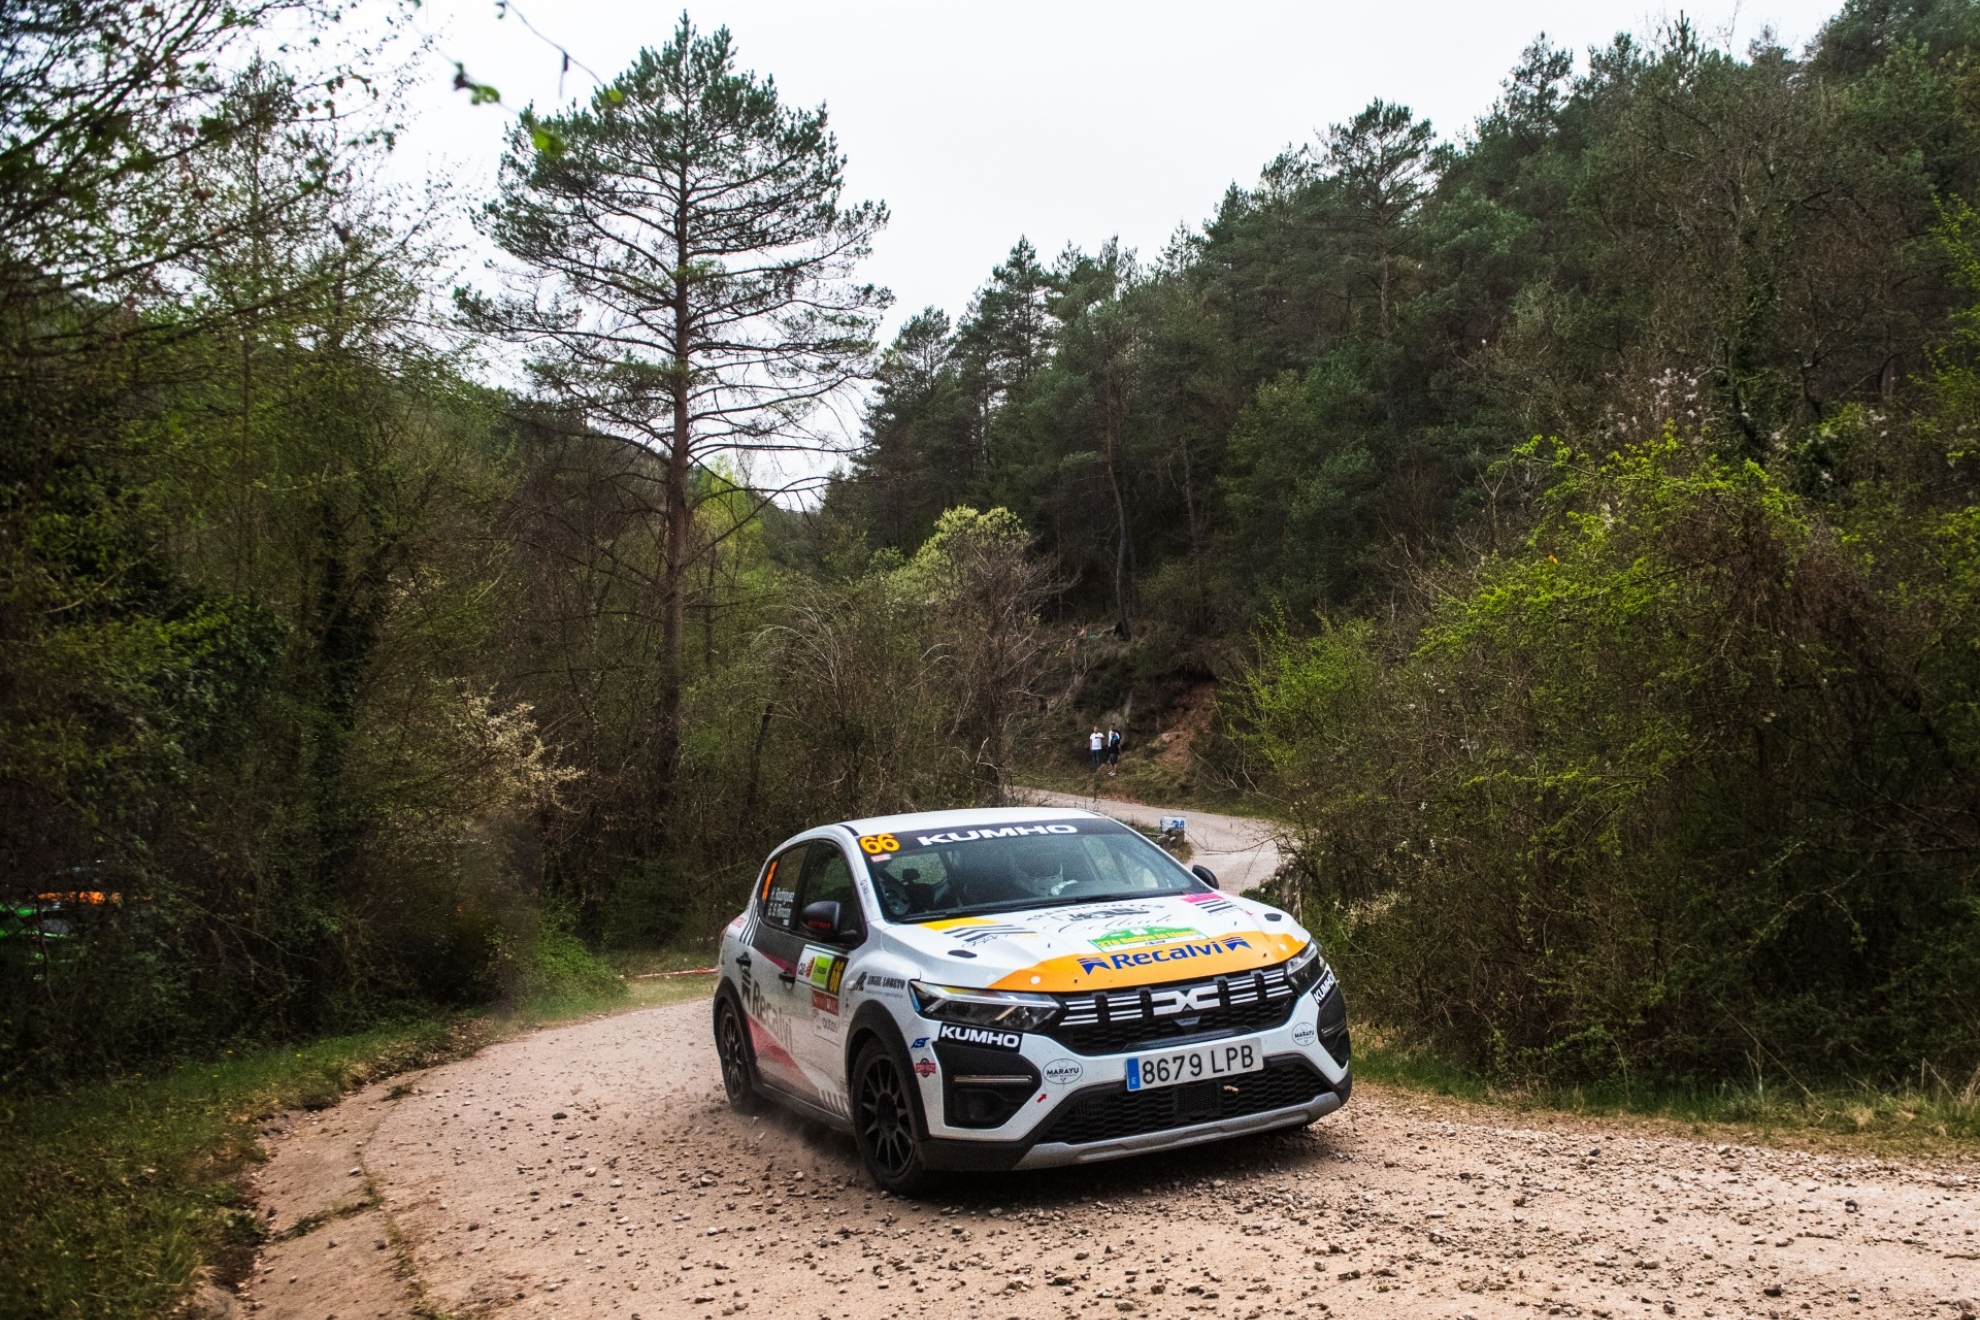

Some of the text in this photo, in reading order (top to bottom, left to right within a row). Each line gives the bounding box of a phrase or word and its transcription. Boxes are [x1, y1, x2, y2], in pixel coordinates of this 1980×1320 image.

[860, 833, 900, 854] 66
[917, 824, 1078, 846] KUMHO
[1110, 941, 1223, 970] Recalvi
[940, 1025, 1019, 1048] KUMHO
[1046, 1067, 1080, 1076] MARAYU
[1142, 1045, 1254, 1084] 8679 LPB
